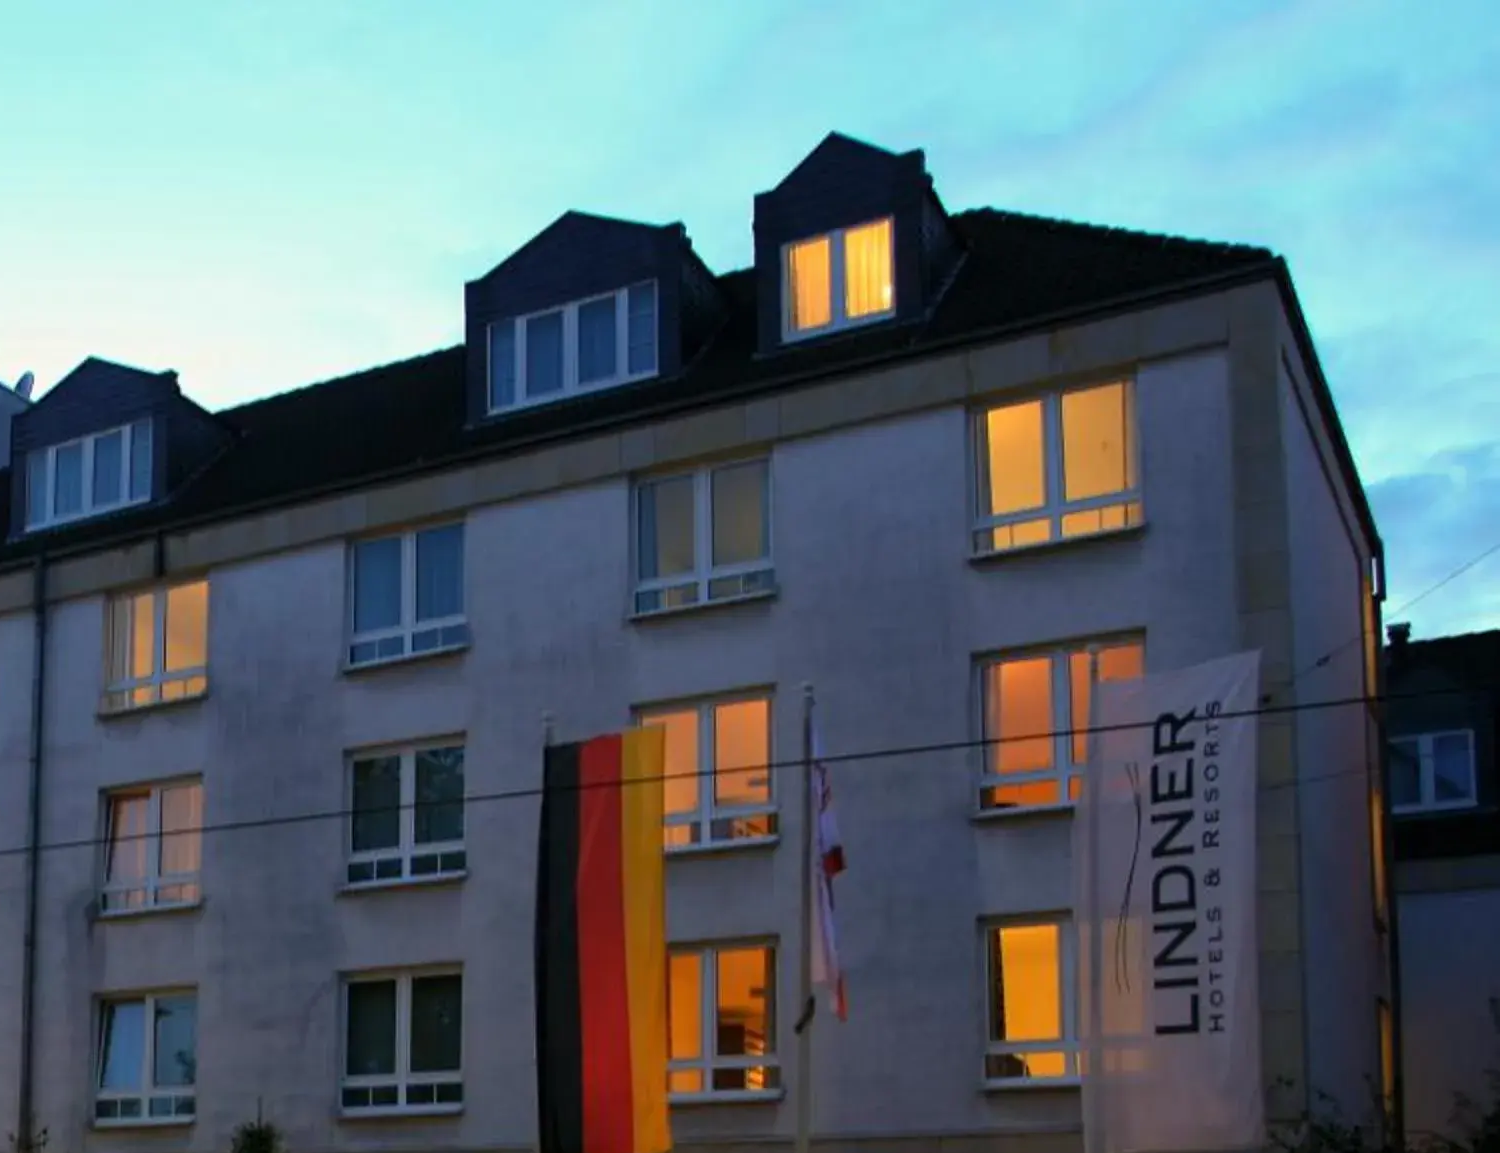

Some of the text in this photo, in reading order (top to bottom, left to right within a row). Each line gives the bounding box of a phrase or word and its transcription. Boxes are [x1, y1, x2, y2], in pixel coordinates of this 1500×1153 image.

[1151, 705, 1200, 1036] LINDNER
[1202, 700, 1225, 1034] HOTELS & RESORTS
